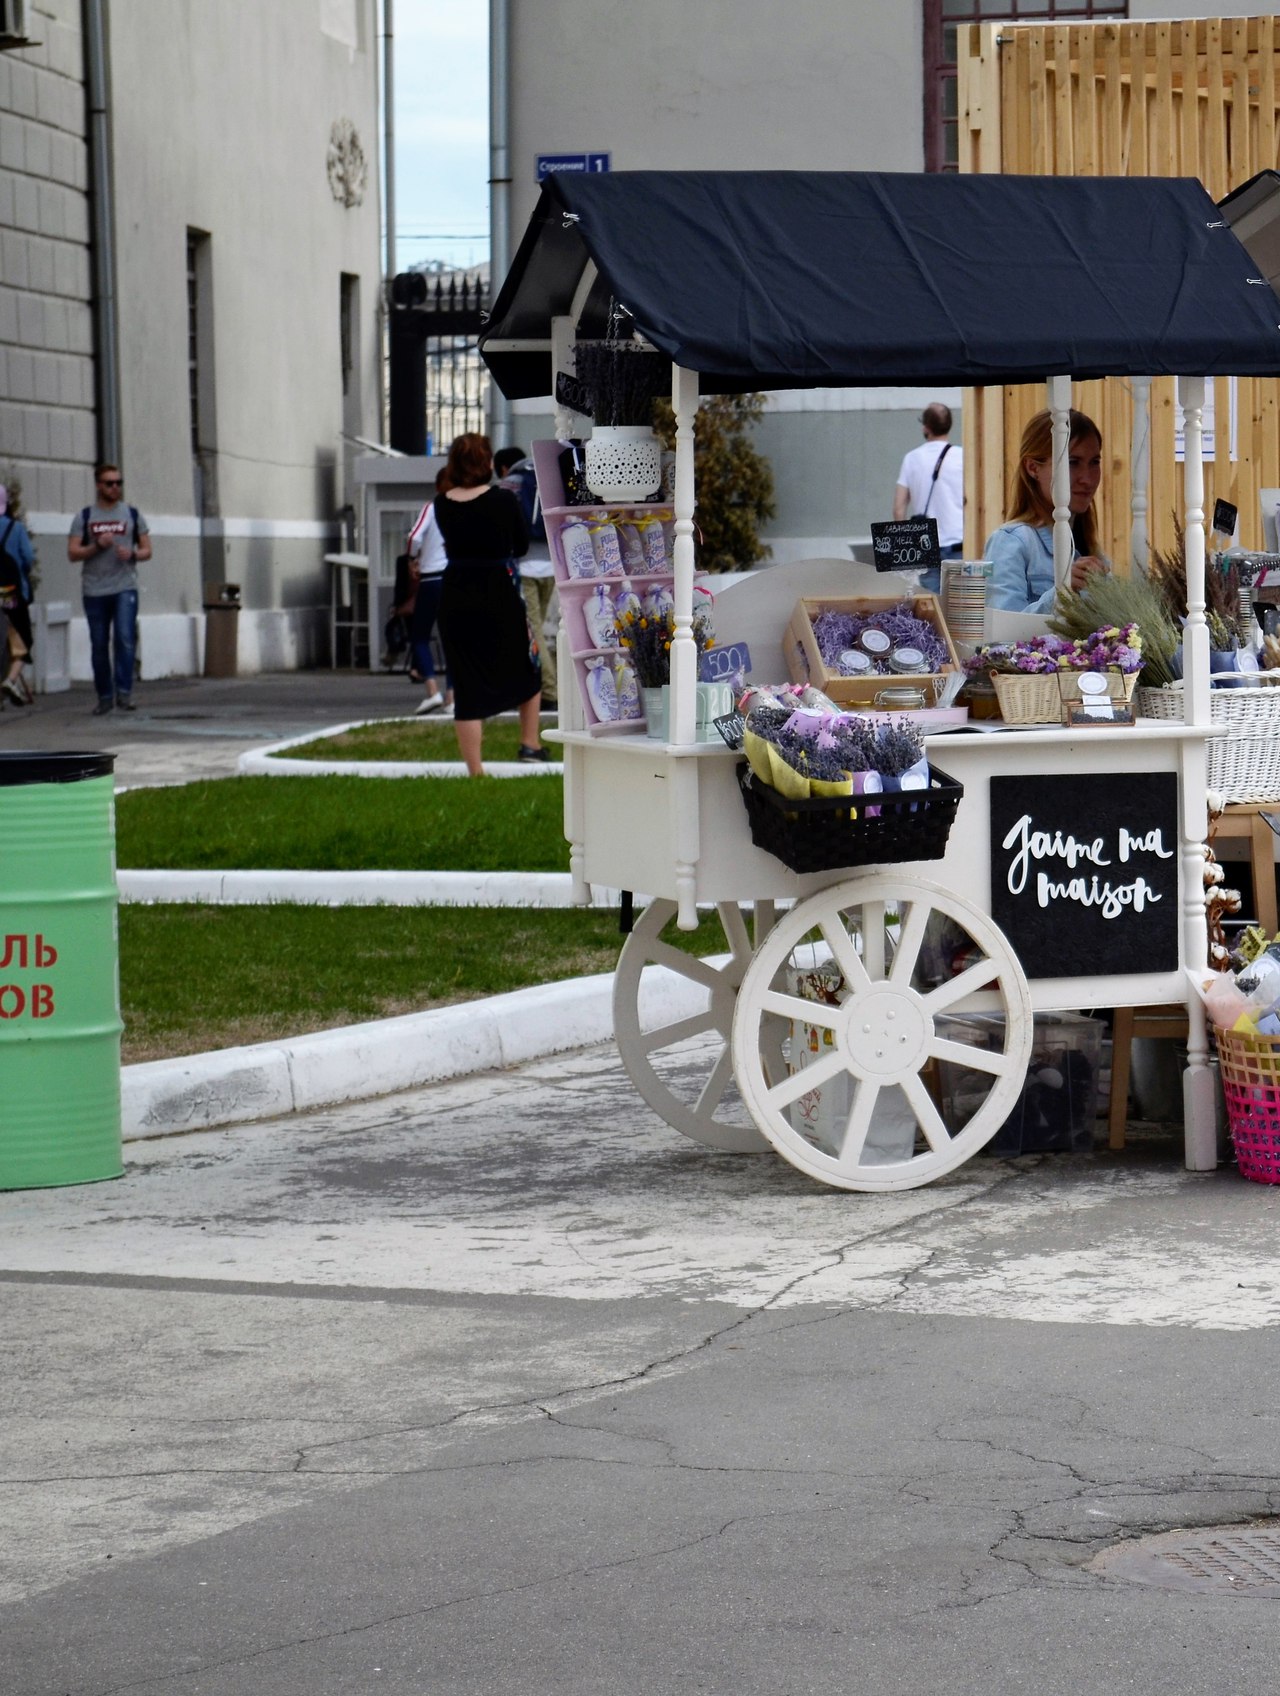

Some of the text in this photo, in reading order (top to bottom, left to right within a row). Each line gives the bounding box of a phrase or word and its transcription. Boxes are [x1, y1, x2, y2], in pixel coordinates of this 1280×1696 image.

[595, 158, 603, 172] 1
[708, 647, 742, 676] 500
[1119, 828, 1174, 863] ma
[1037, 872, 1163, 920] maison
